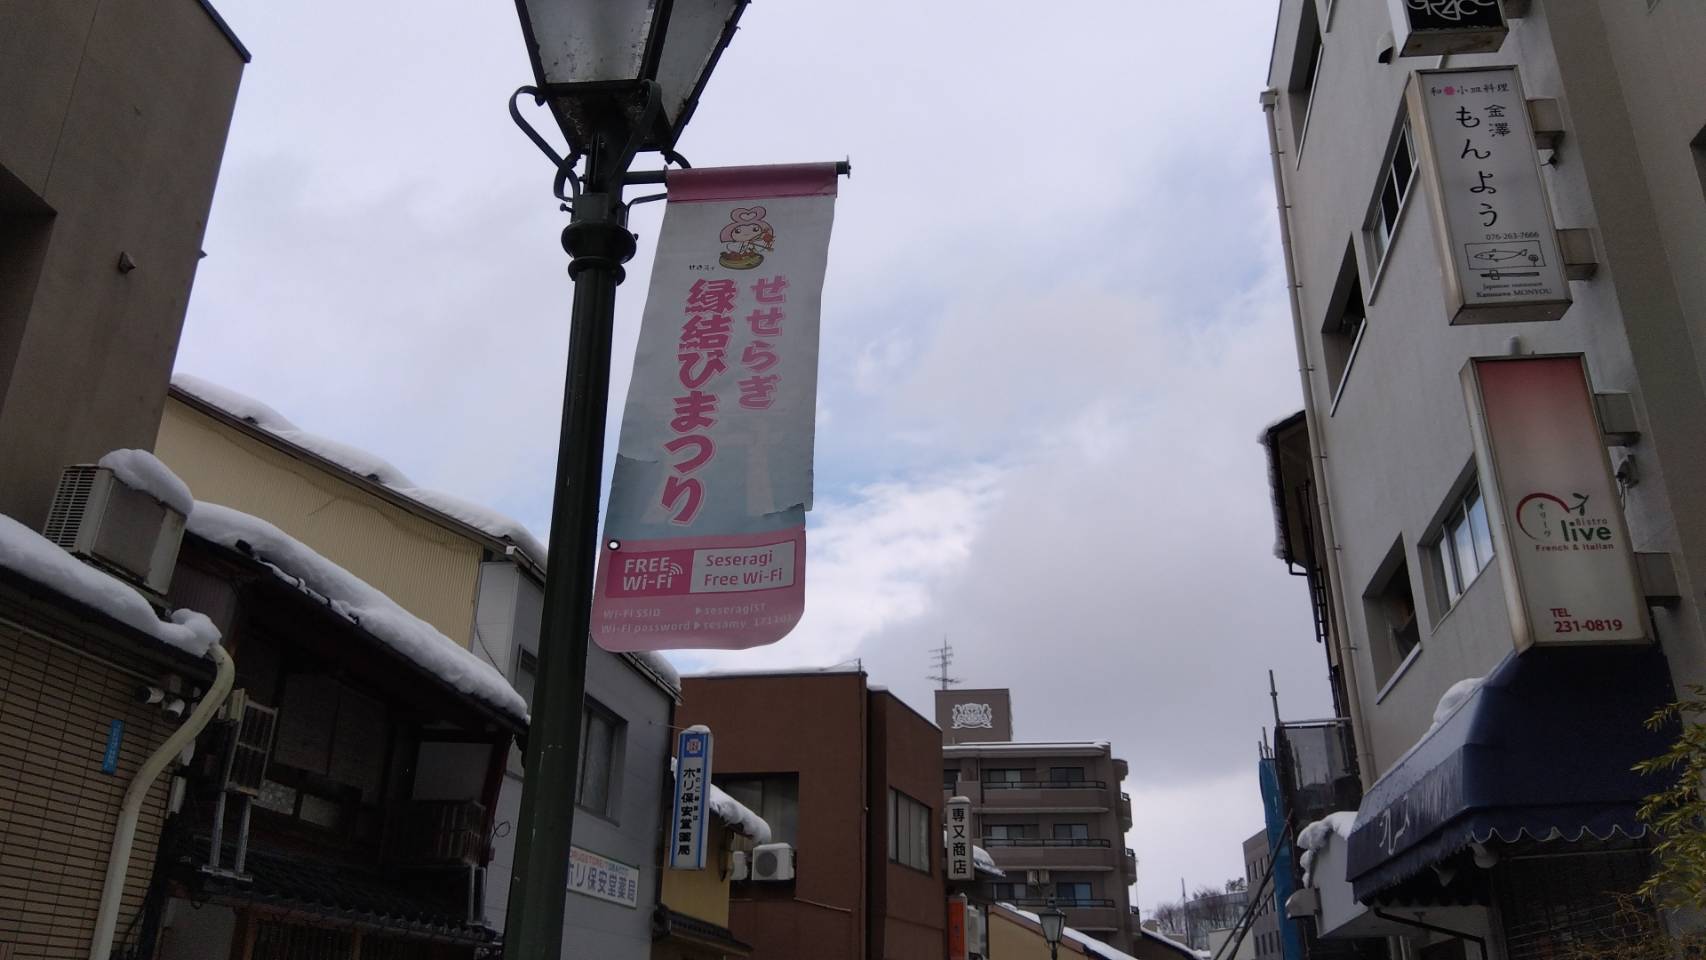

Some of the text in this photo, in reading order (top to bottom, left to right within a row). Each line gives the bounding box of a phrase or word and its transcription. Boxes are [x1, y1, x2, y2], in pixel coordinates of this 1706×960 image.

[1455, 105, 1498, 227] もんよう
[736, 274, 791, 410] せせらぎ
[660, 278, 738, 525] 縁結びまつり
[1535, 543, 1569, 552] French
[624, 557, 671, 574] FREE
[706, 550, 773, 567] Seseragi
[623, 573, 673, 591] Wi-Fi
[704, 567, 783, 586] Free Wi-Fi
[1550, 607, 1572, 618] TEL
[1554, 619, 1623, 633] 231-0819
